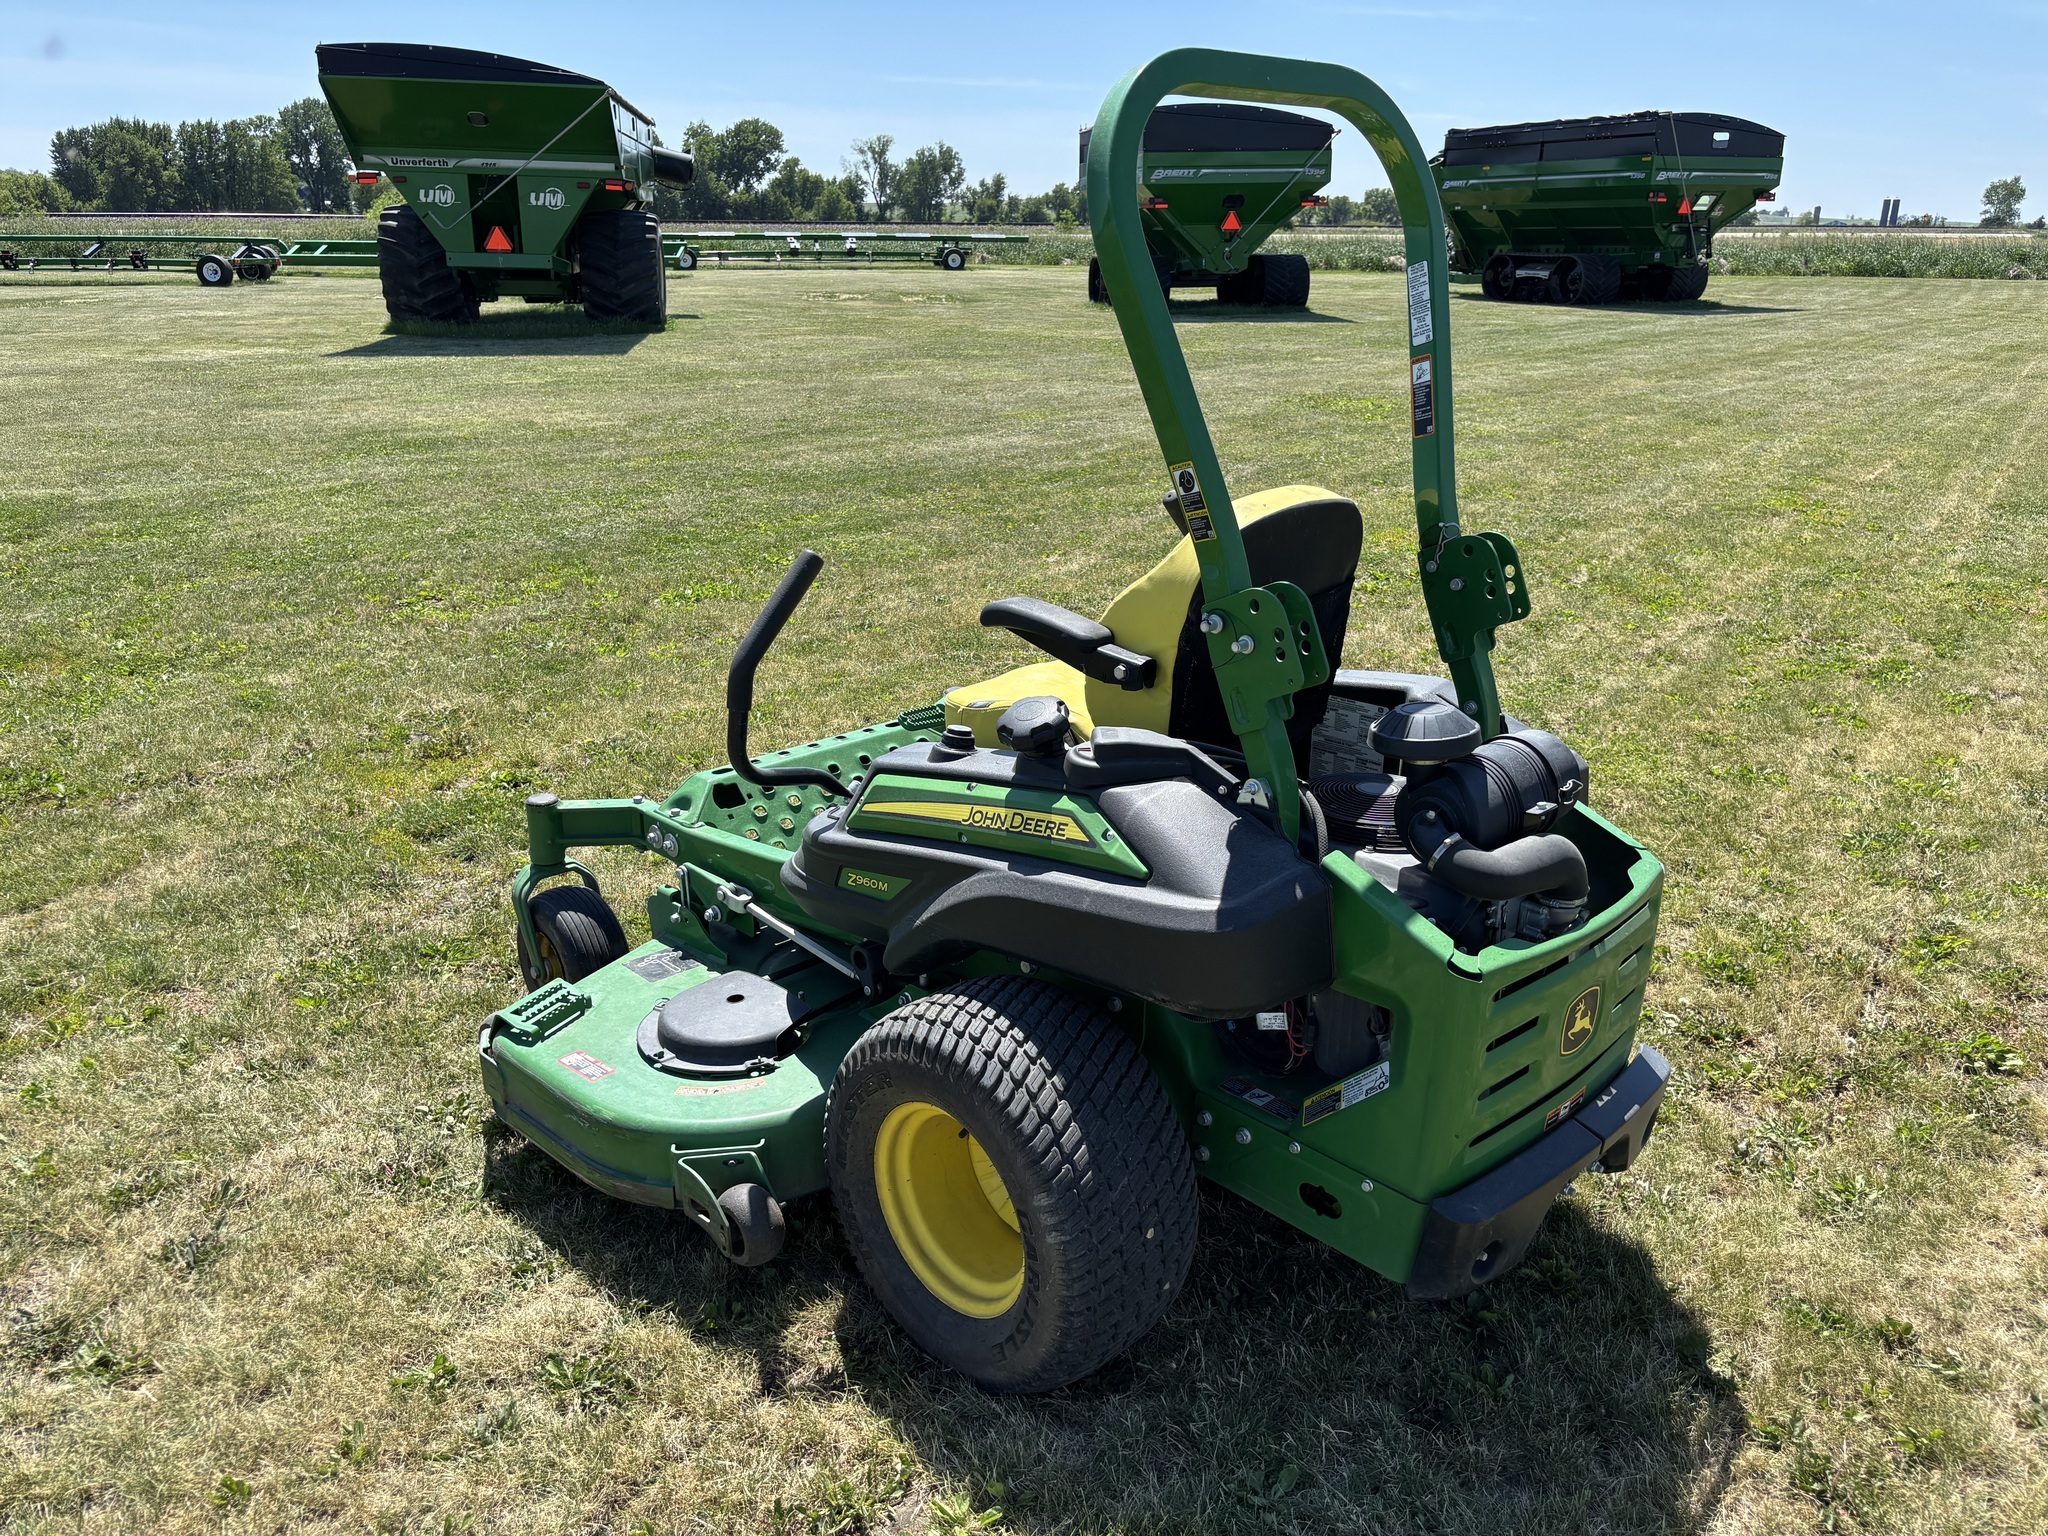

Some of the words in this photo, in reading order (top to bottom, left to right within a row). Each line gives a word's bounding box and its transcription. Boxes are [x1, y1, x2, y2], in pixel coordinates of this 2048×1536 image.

[391, 157, 449, 167] Unverferth
[1150, 169, 1197, 180] BRENT
[961, 806, 1008, 829] JOHN
[1009, 811, 1069, 837] DEERE
[847, 872, 889, 892] Z960M
